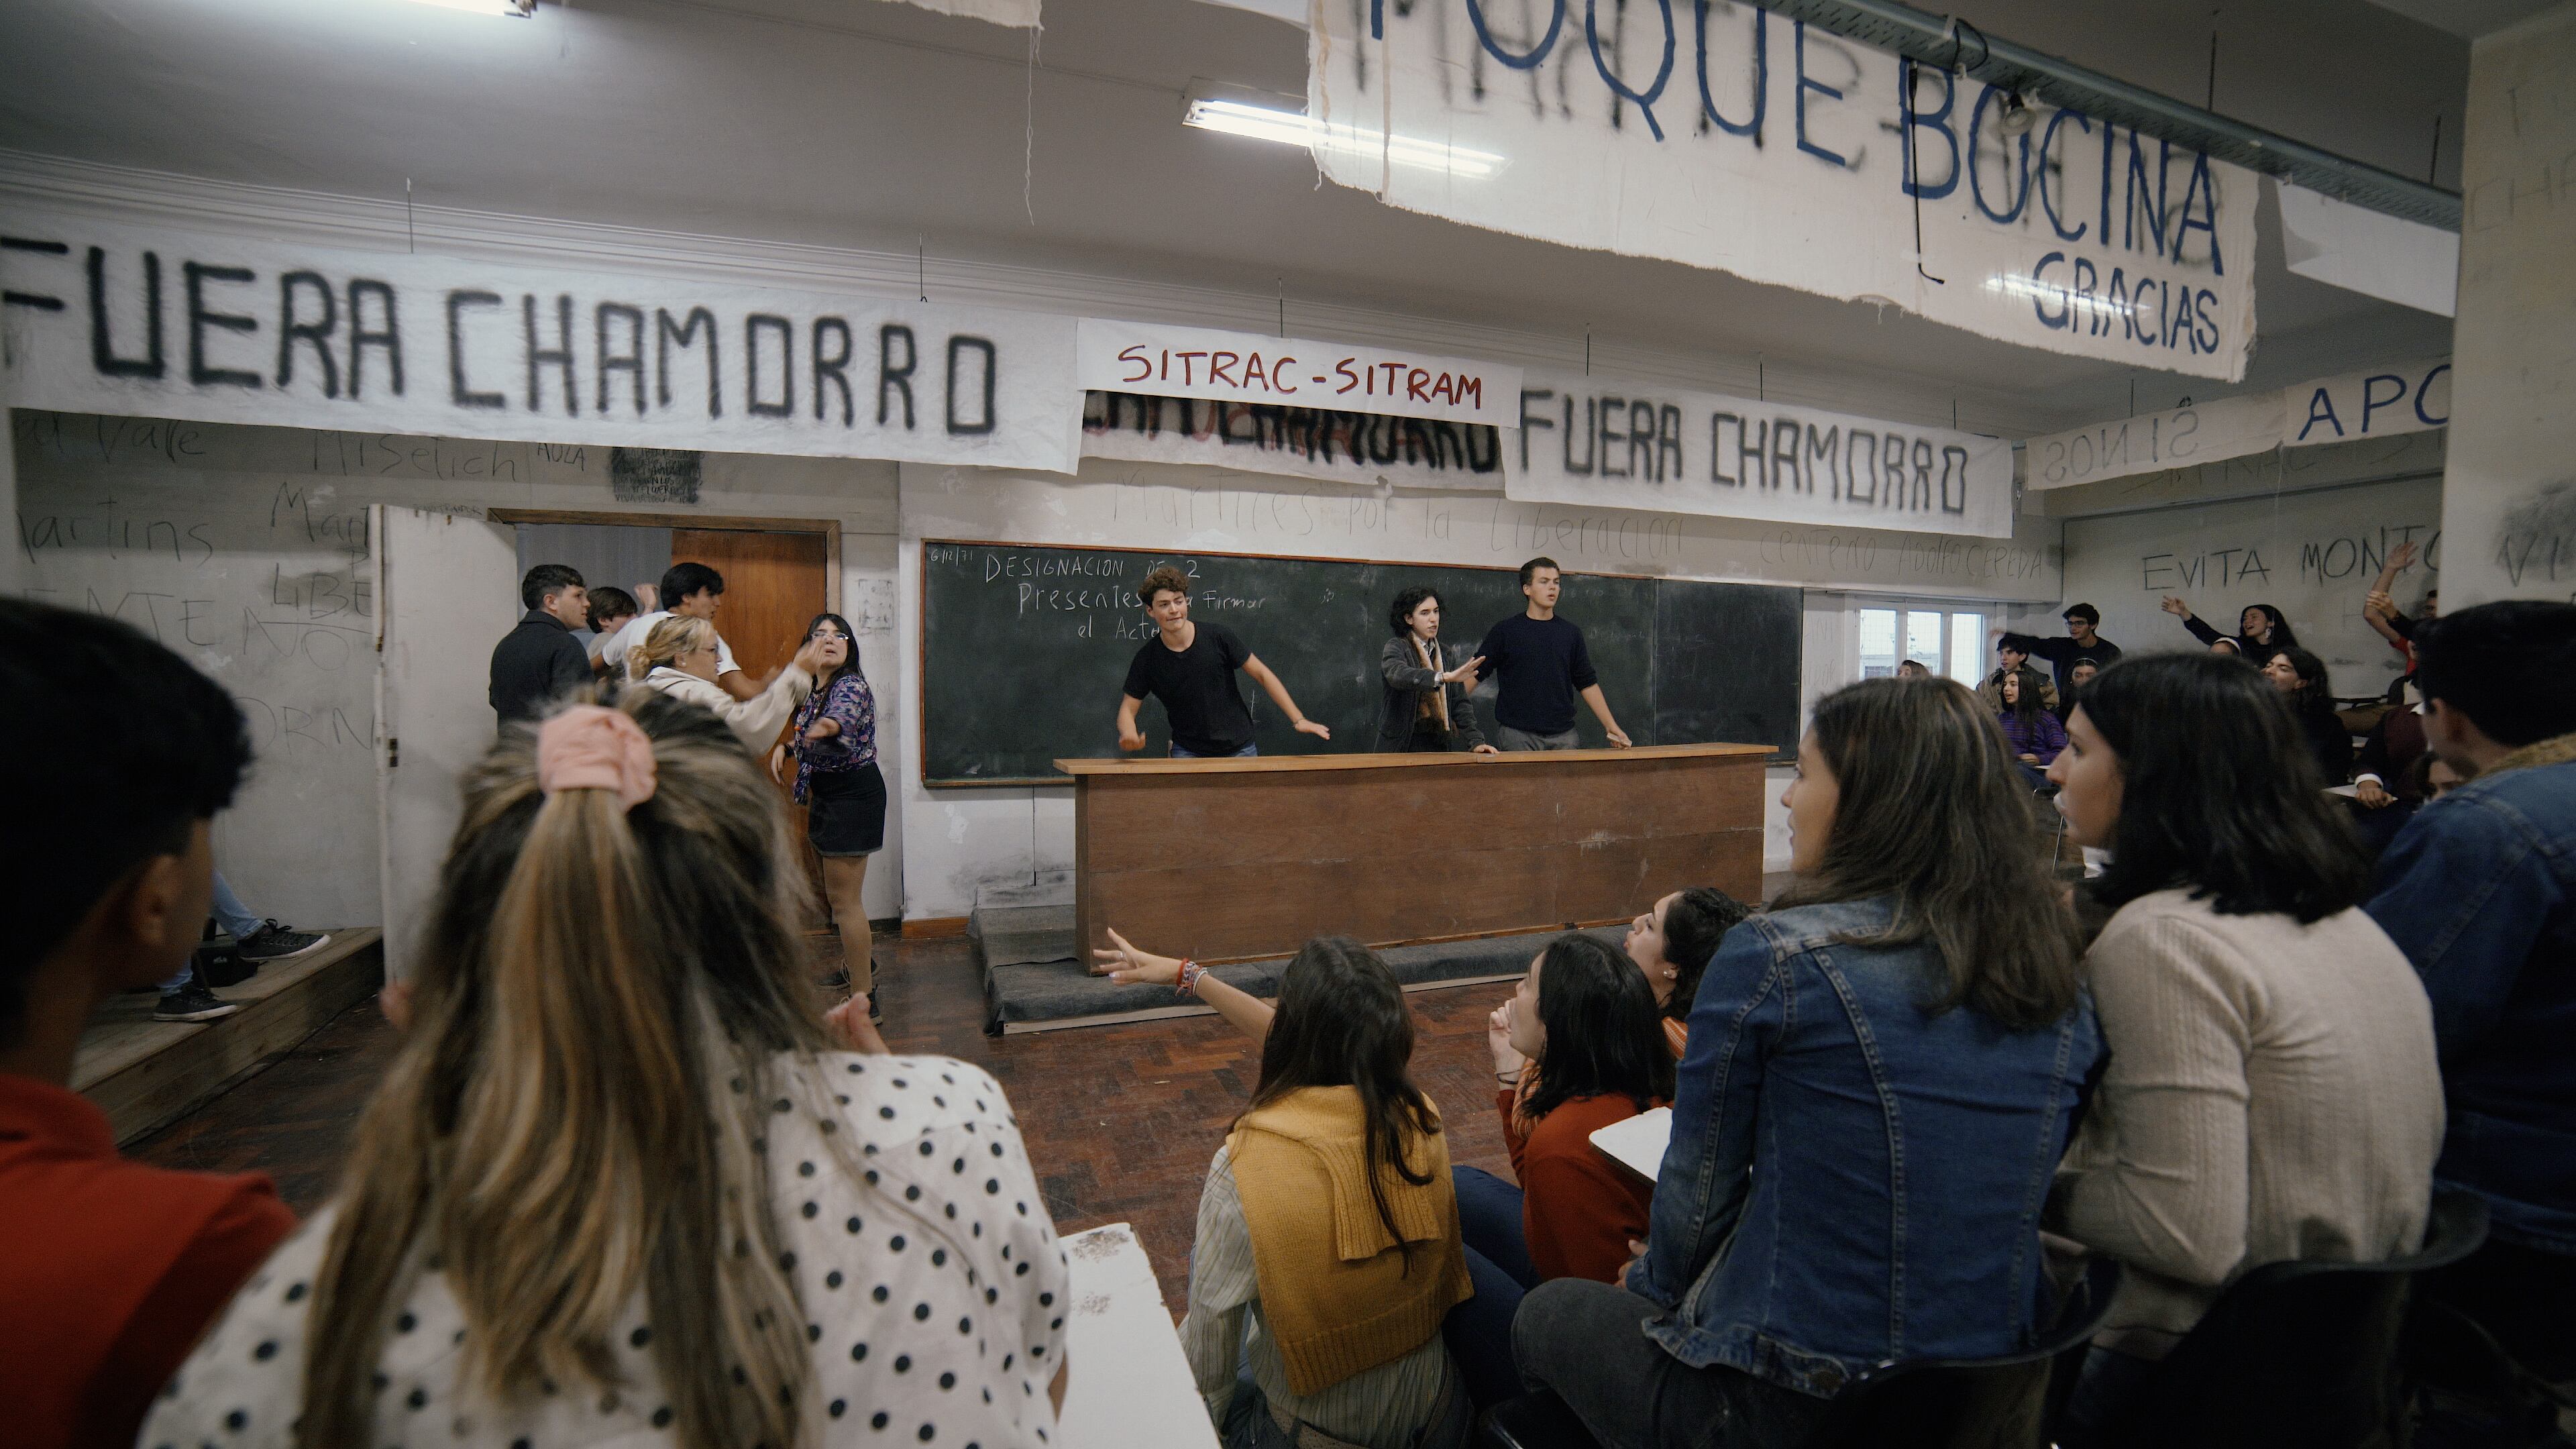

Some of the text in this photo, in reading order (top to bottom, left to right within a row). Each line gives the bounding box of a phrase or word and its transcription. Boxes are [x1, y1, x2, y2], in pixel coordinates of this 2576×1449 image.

[1898, 55, 2224, 276] BOCINA
[2032, 251, 2220, 356] GRACIAS
[446, 288, 997, 435] CHAMORRO
[1519, 388, 1683, 483] FUERA
[1711, 411, 1967, 514] CHAMORRO
[985, 553, 1124, 583] DESIGNACION
[1186, 559, 1201, 578] 2
[1077, 614, 1093, 639] el
